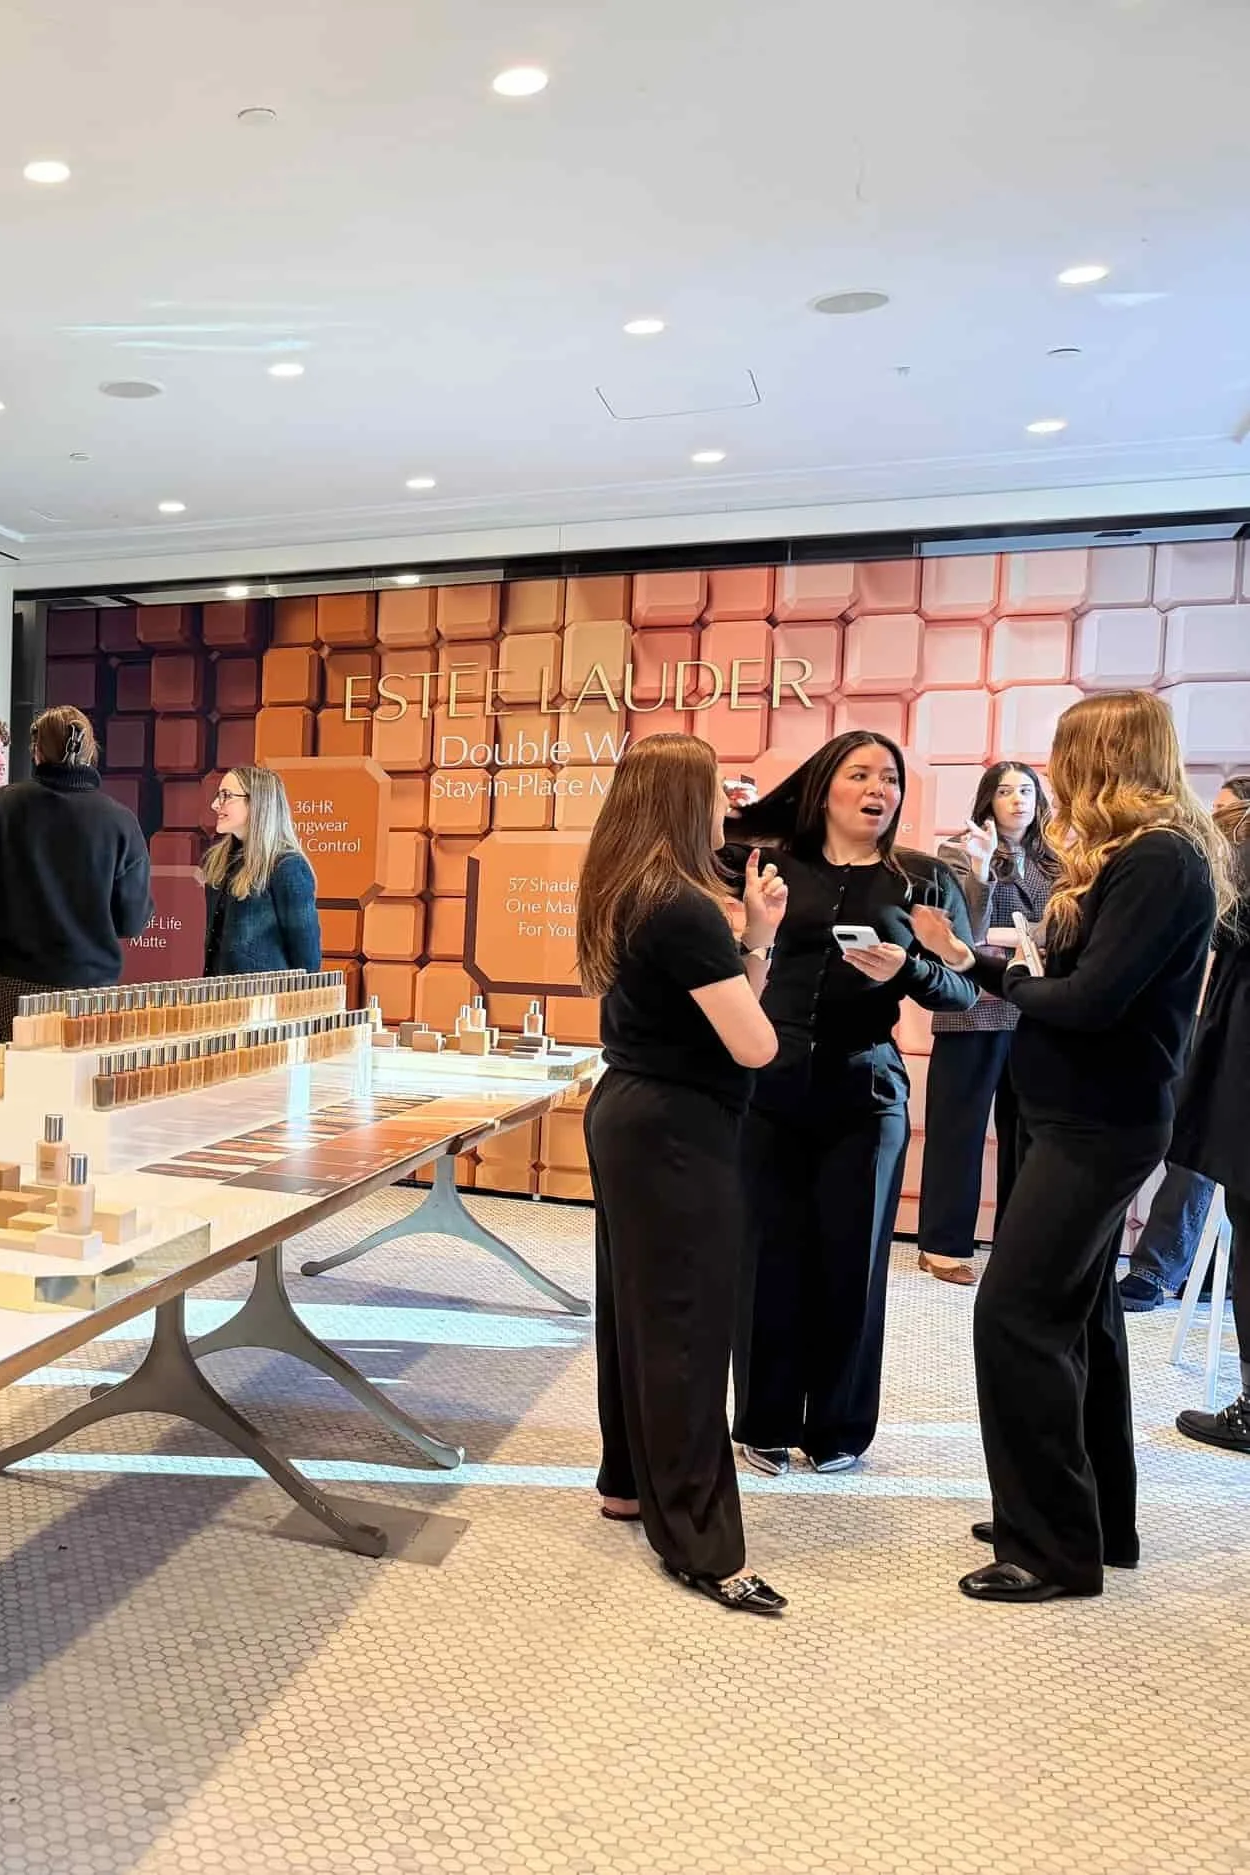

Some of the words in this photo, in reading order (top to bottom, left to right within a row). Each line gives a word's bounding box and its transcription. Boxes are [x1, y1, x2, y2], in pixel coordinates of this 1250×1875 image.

[540, 656, 816, 713] LAUDER
[439, 729, 572, 767] Double
[430, 772, 583, 804] Stay-in-Place
[293, 800, 334, 814] 36HR
[292, 820, 349, 836] ongwear
[306, 838, 361, 852] Control
[509, 877, 527, 892] 57
[529, 876, 580, 893] Shade
[505, 898, 542, 913] One
[518, 921, 543, 936] For
[129, 935, 167, 948] Matte
